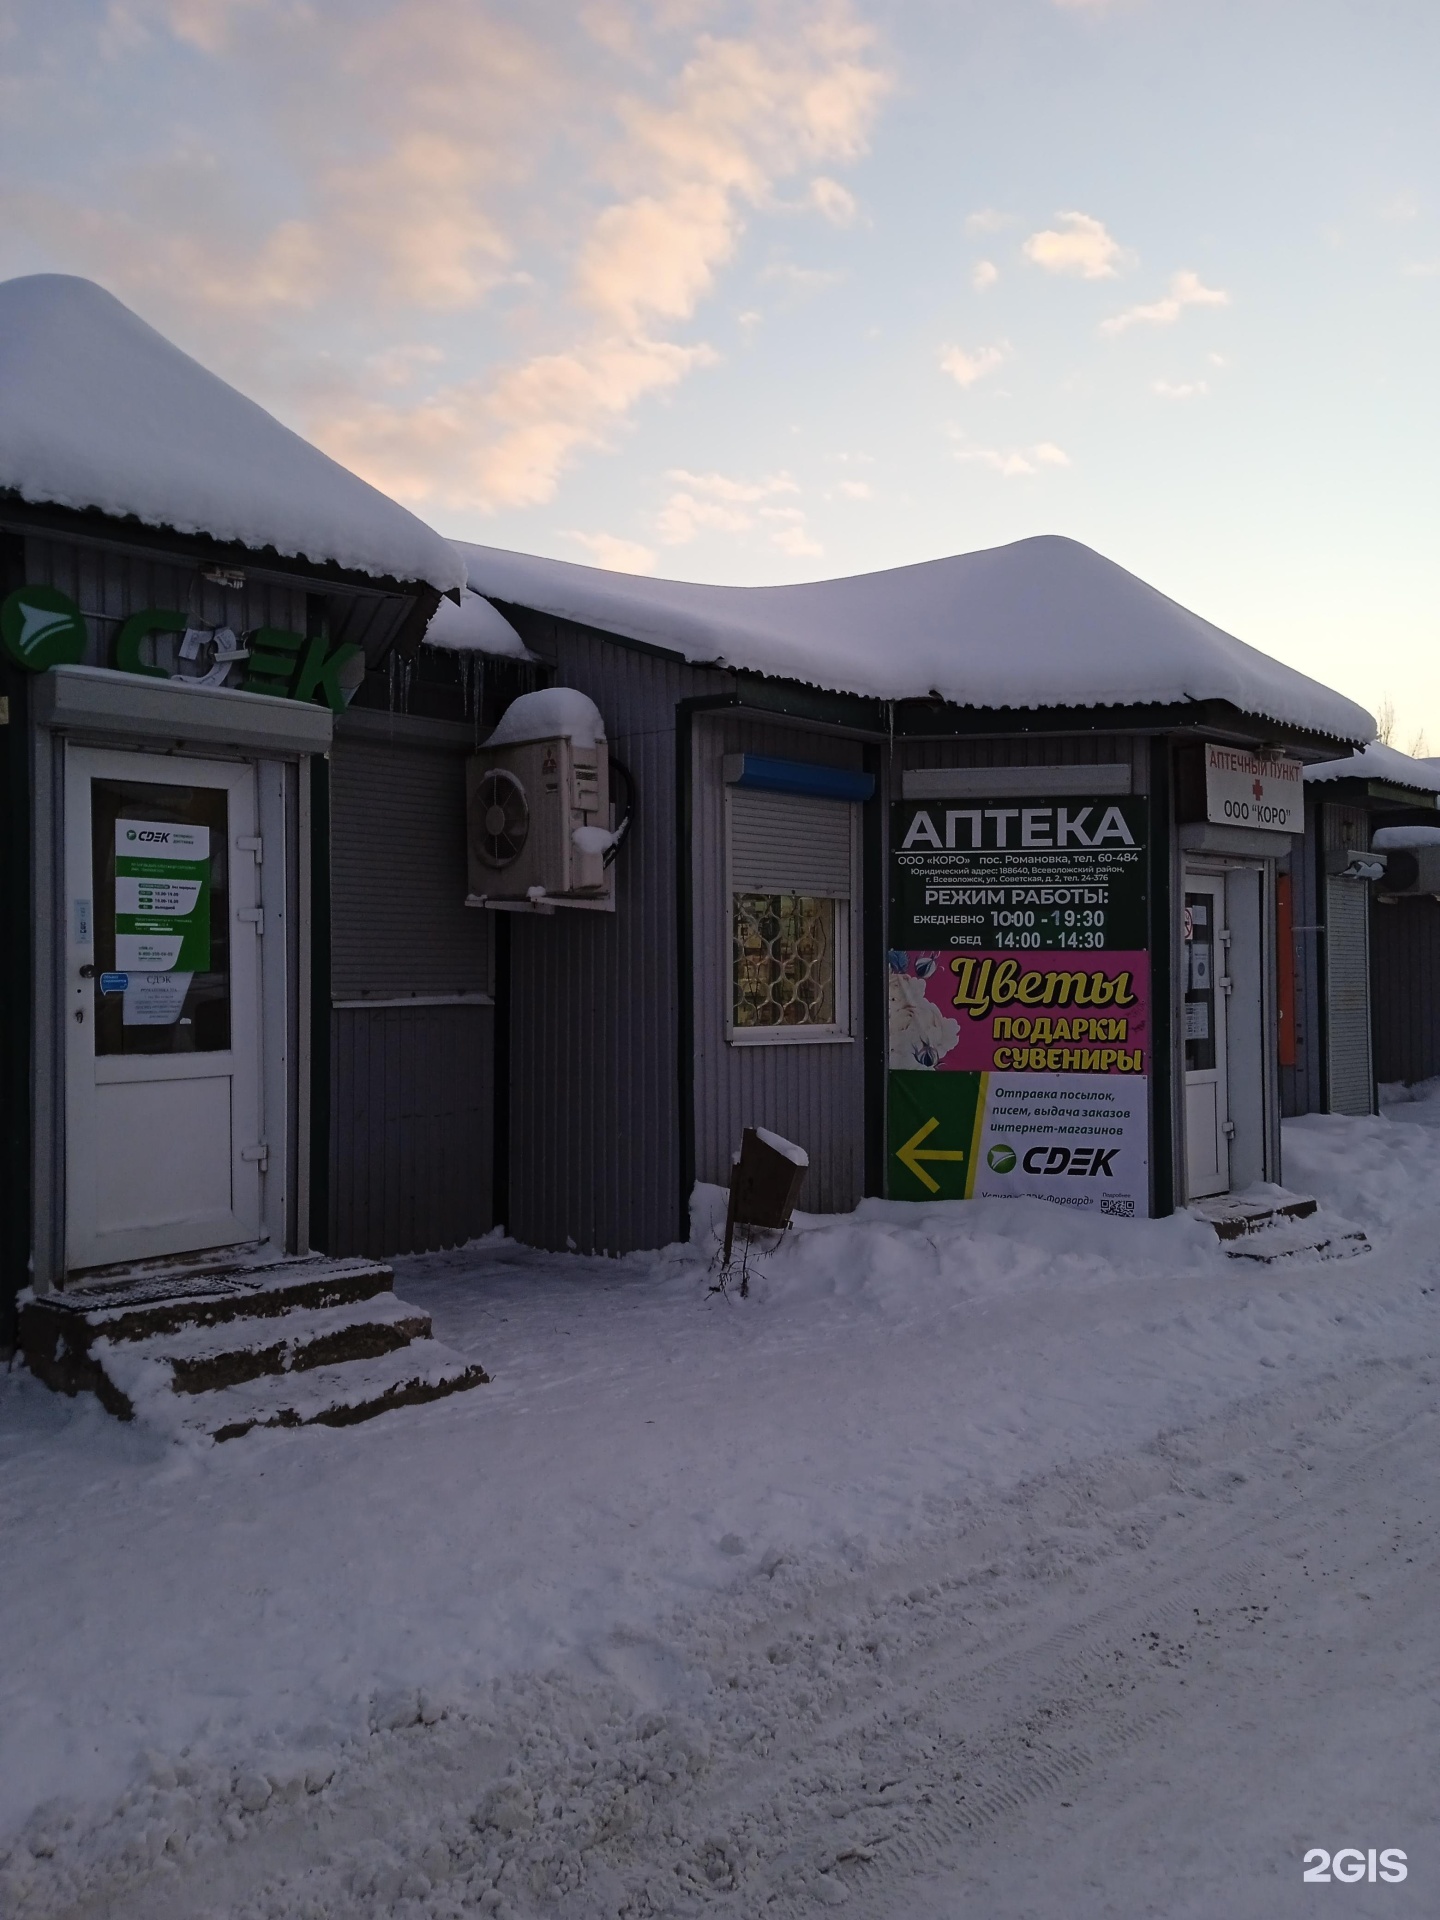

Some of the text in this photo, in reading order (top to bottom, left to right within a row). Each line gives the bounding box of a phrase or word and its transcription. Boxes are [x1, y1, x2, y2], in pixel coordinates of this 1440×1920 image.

[1209, 750, 1300, 782] АПТЕЧНЫЙ ПУНКТ
[1224, 800, 1249, 819] ООО
[901, 806, 1135, 849] АПТЕКА
[138, 830, 171, 843] CDEK
[897, 856, 924, 865] ООО
[926, 855, 971, 865] «КОРО»
[1005, 855, 1071, 865] Романовка,
[1073, 855, 1095, 863] тел.
[1098, 853, 1139, 863] 60-484
[910, 866, 1125, 876] Юридический адрес: 188640, Всеволожский район,
[933, 876, 985, 884] Всеволожск,
[999, 875, 1044, 883] Советская,
[1054, 875, 1062, 883] 2,
[1080, 873, 1109, 882] 24-376
[925, 889, 1109, 905] РЕЖИМ РАБОТЫ:
[913, 915, 985, 925] ЕЖЕДНЕВНО
[990, 910, 1034, 927] 10:00
[950, 936, 982, 946] ОБЕД
[995, 932, 1041, 948] 14:00
[1057, 931, 1105, 948] 14:30
[146, 975, 172, 985] СДЭК
[949, 957, 1135, 1017] Цветы
[992, 1016, 1128, 1044] ПОДАРКИ
[992, 1046, 1143, 1071] СУВЕНИРЫ
[995, 1087, 1116, 1103] Отправка посылок,
[992, 1104, 1131, 1120] писем, выдача заказов
[990, 1122, 1124, 1136] интернет-магазинов
[1022, 1146, 1122, 1177] CDEK
